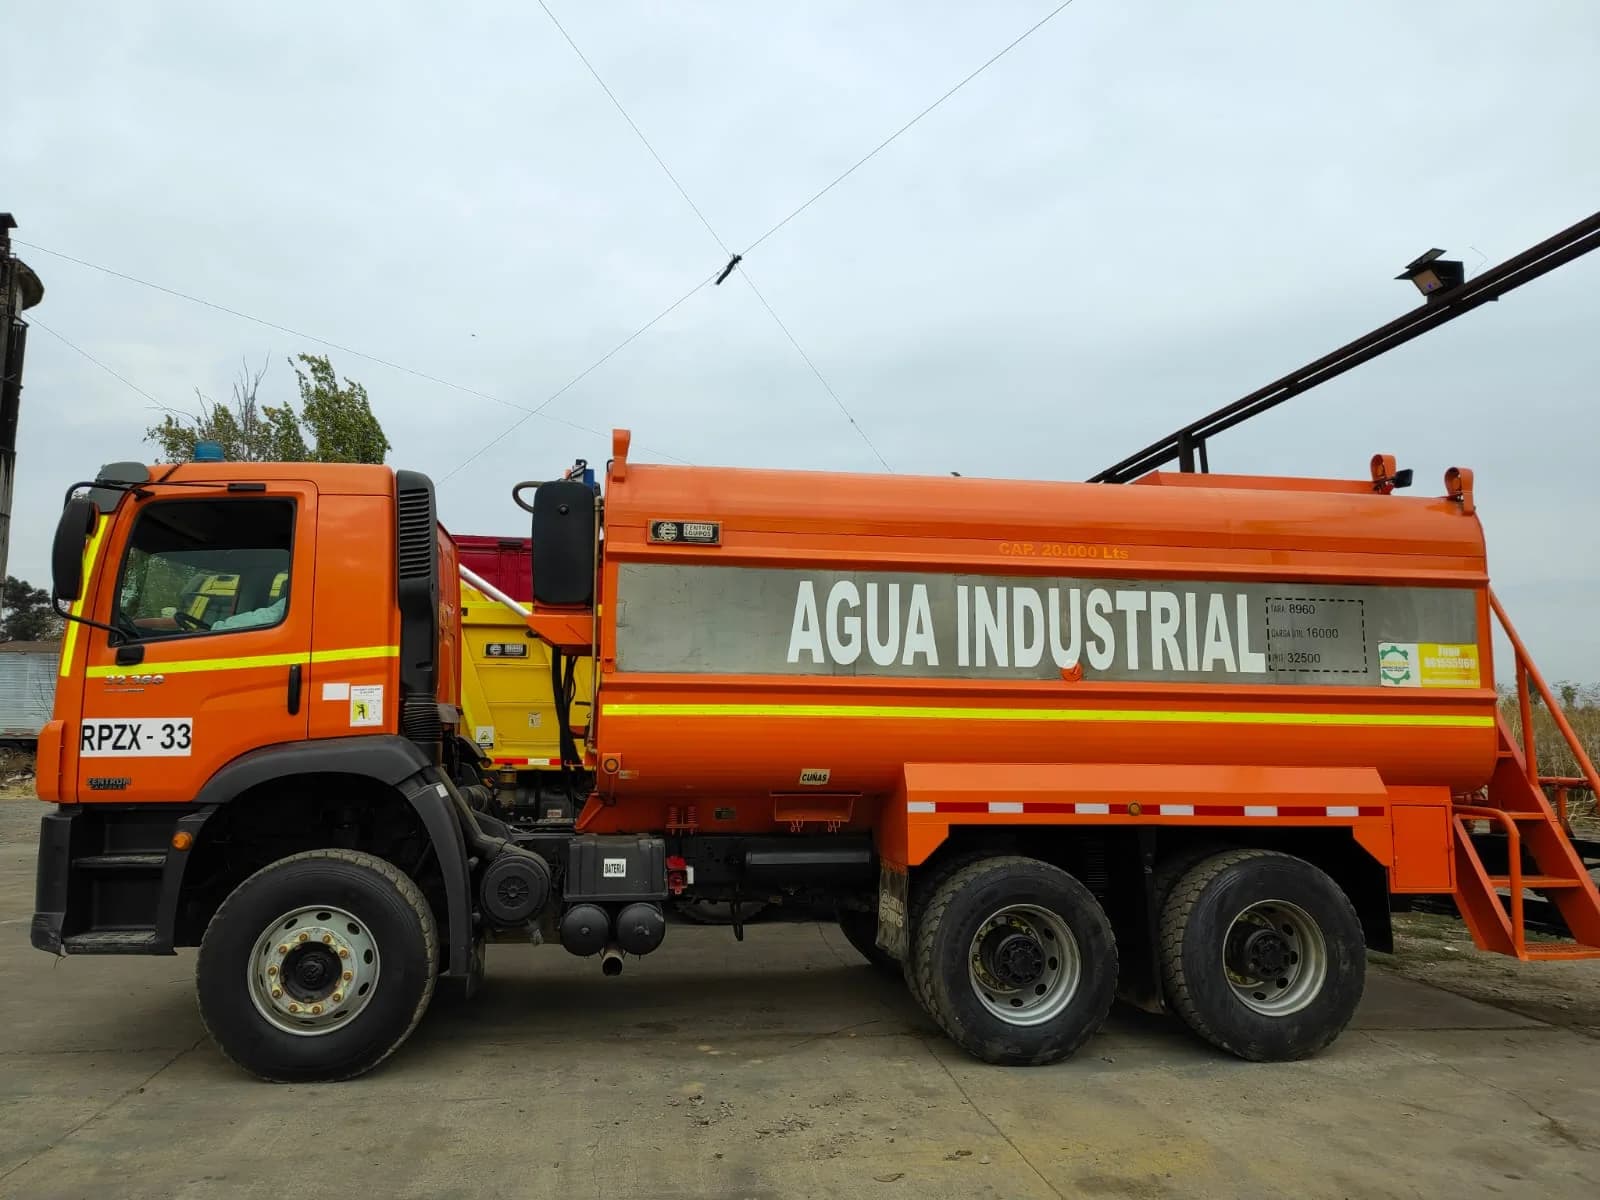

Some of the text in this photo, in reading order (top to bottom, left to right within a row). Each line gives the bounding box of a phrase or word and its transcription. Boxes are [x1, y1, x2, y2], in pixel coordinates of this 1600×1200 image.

[1000, 542, 1129, 559] CAP. 20.000 Lts
[1289, 603, 1316, 614] 8960
[787, 580, 1267, 674] AGUA INDUSTRIAL
[1306, 627, 1339, 639] 16000
[1287, 652, 1321, 663] 32500
[81, 723, 142, 751] RPZX
[160, 723, 192, 750] 33
